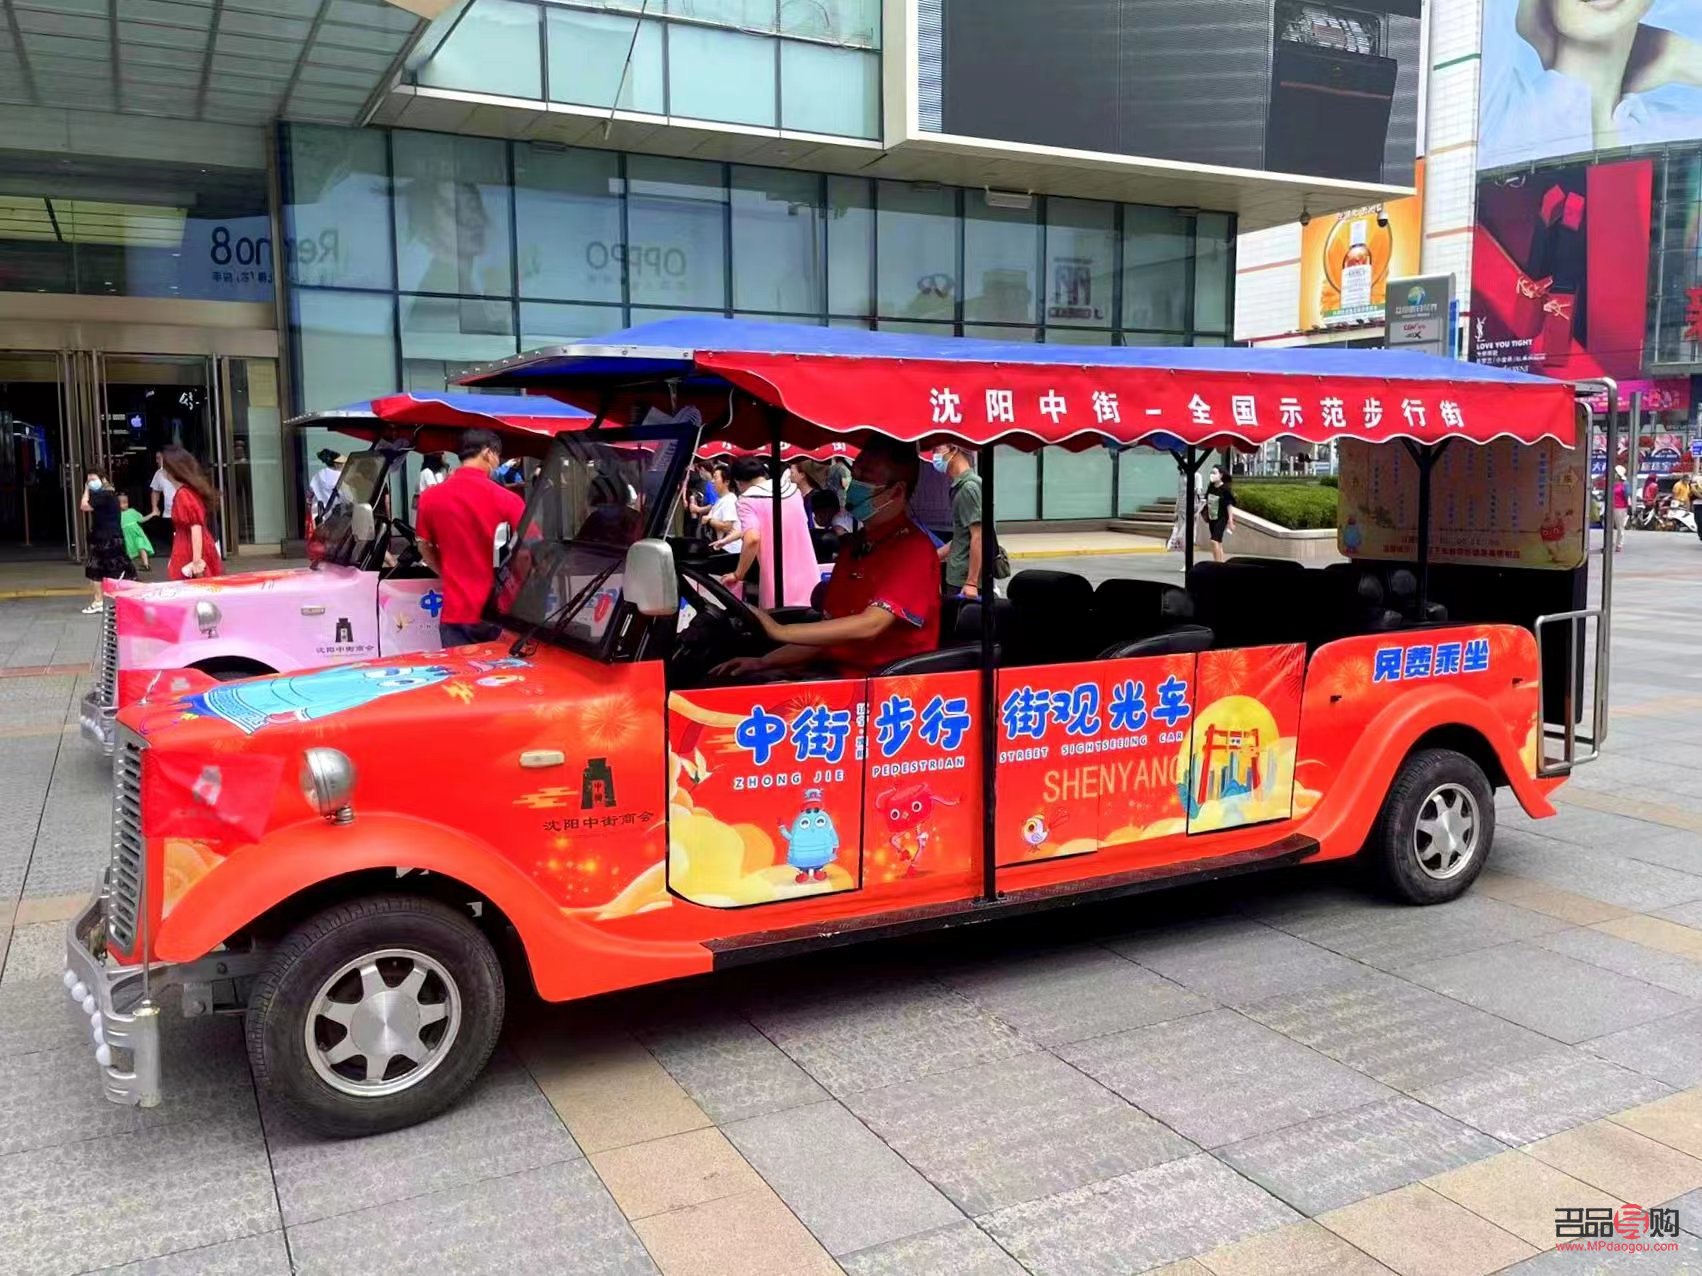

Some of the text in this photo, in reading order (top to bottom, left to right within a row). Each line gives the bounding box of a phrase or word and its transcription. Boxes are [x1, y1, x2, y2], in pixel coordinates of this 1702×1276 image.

[1476, 342, 1494, 350] LOVE
[1511, 339, 1533, 347] TIGHT
[1373, 639, 1488, 682] 免费乘坐
[999, 747, 1049, 763] STREET
[1158, 731, 1184, 744] CAR
[872, 757, 965, 777] PEDESTRIAN
[733, 770, 845, 789] ZHONG JIE
[543, 811, 654, 831] 沈阳中街商会
